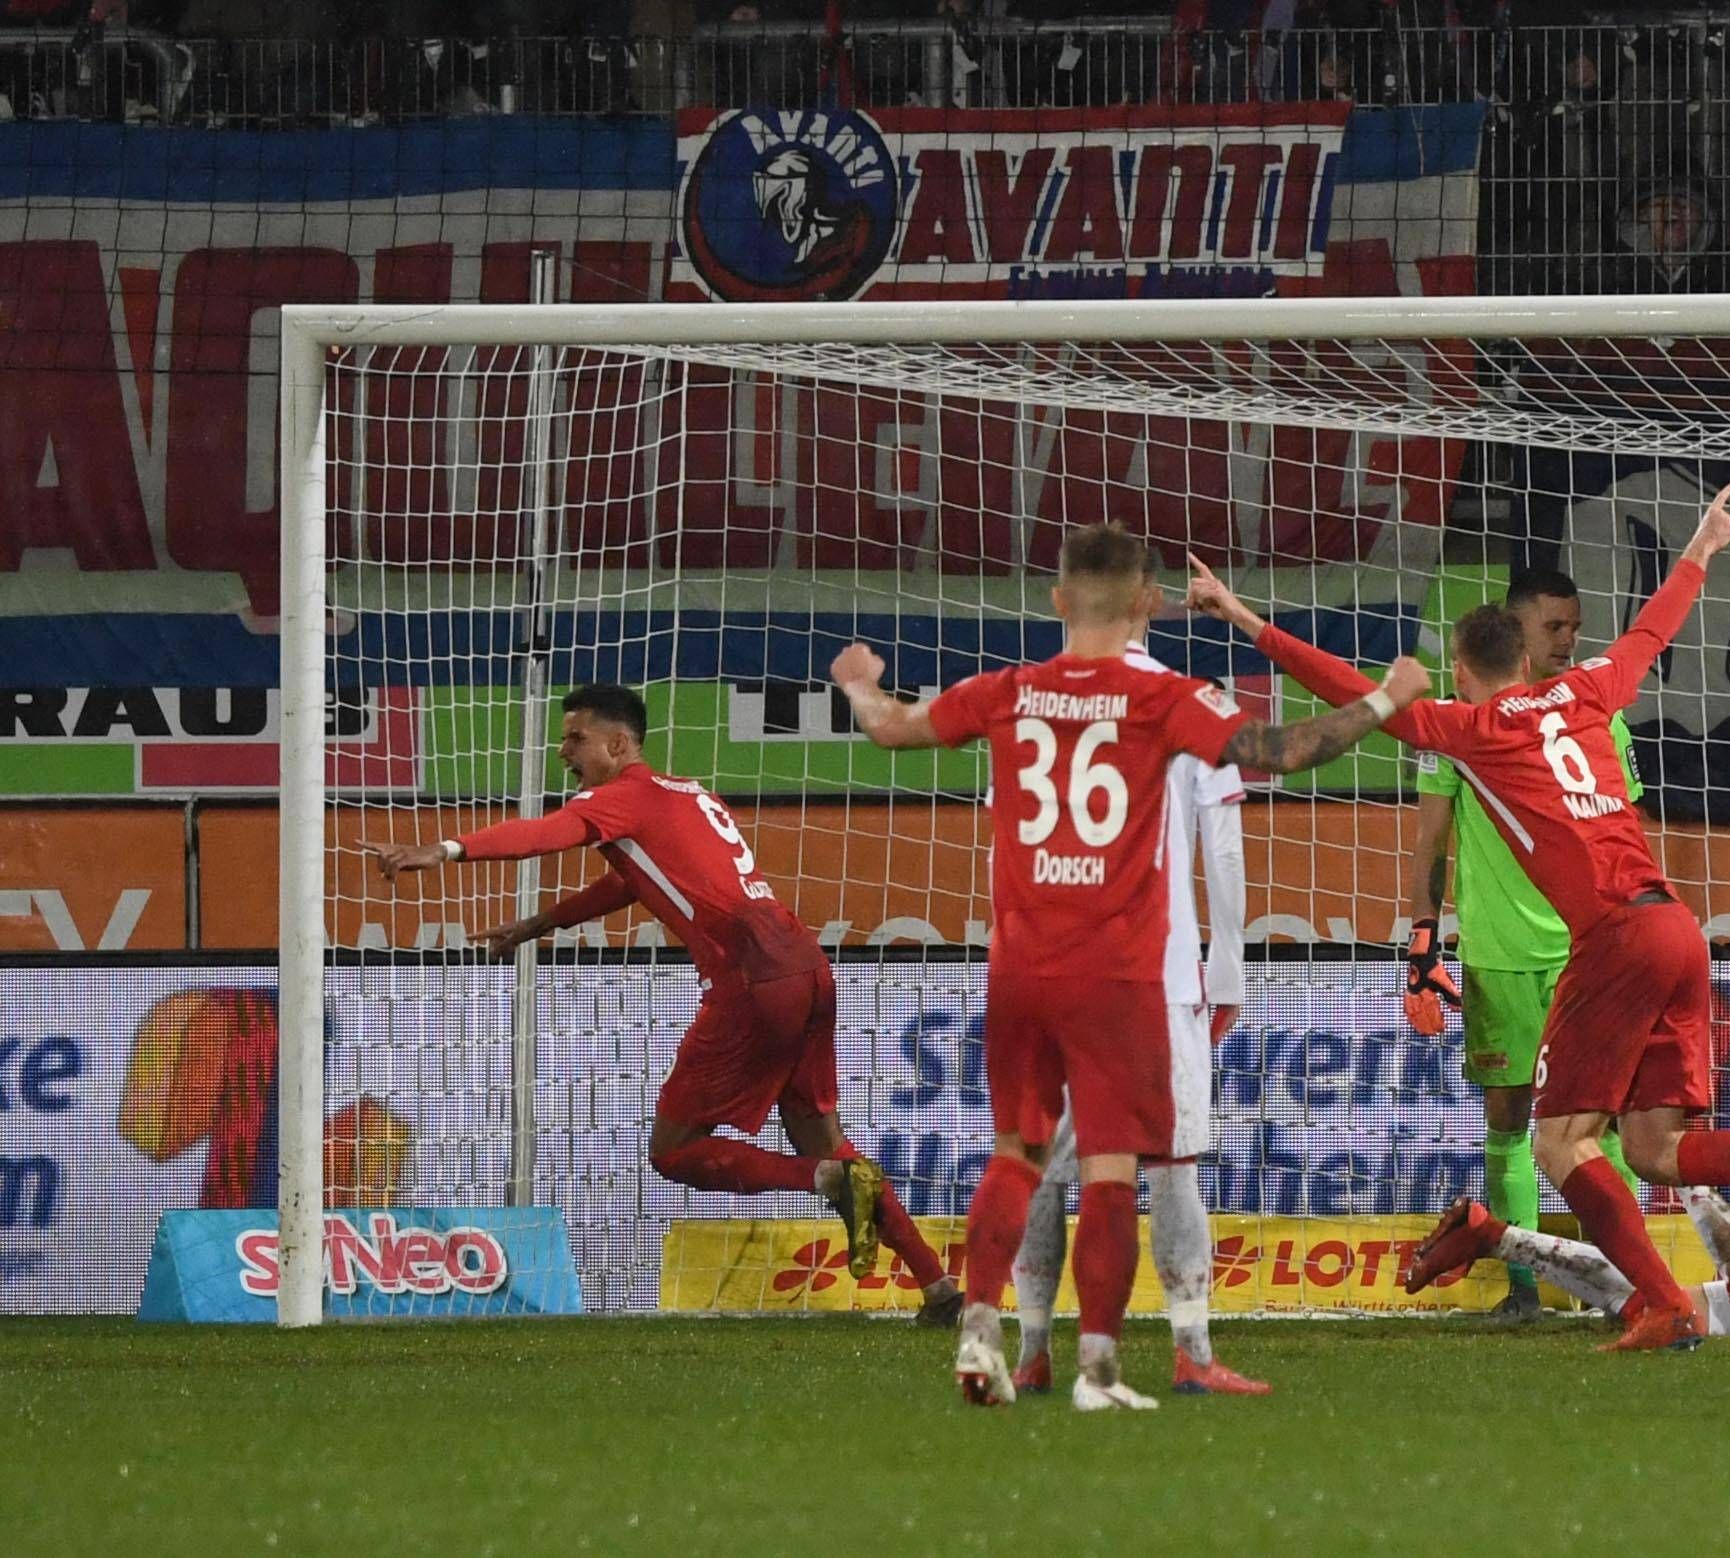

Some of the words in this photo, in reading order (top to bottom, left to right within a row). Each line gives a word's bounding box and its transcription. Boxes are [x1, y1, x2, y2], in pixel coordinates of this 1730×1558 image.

[741, 111, 885, 189] AVANTI
[898, 142, 1321, 265] AVANTI
[1014, 684, 1128, 720] HEIDENHEIM
[1015, 718, 1129, 847] 36
[1539, 711, 1597, 794] 6
[697, 793, 755, 875] 9
[1033, 848, 1105, 884] DORSCH
[1535, 1043, 1549, 1089] 6
